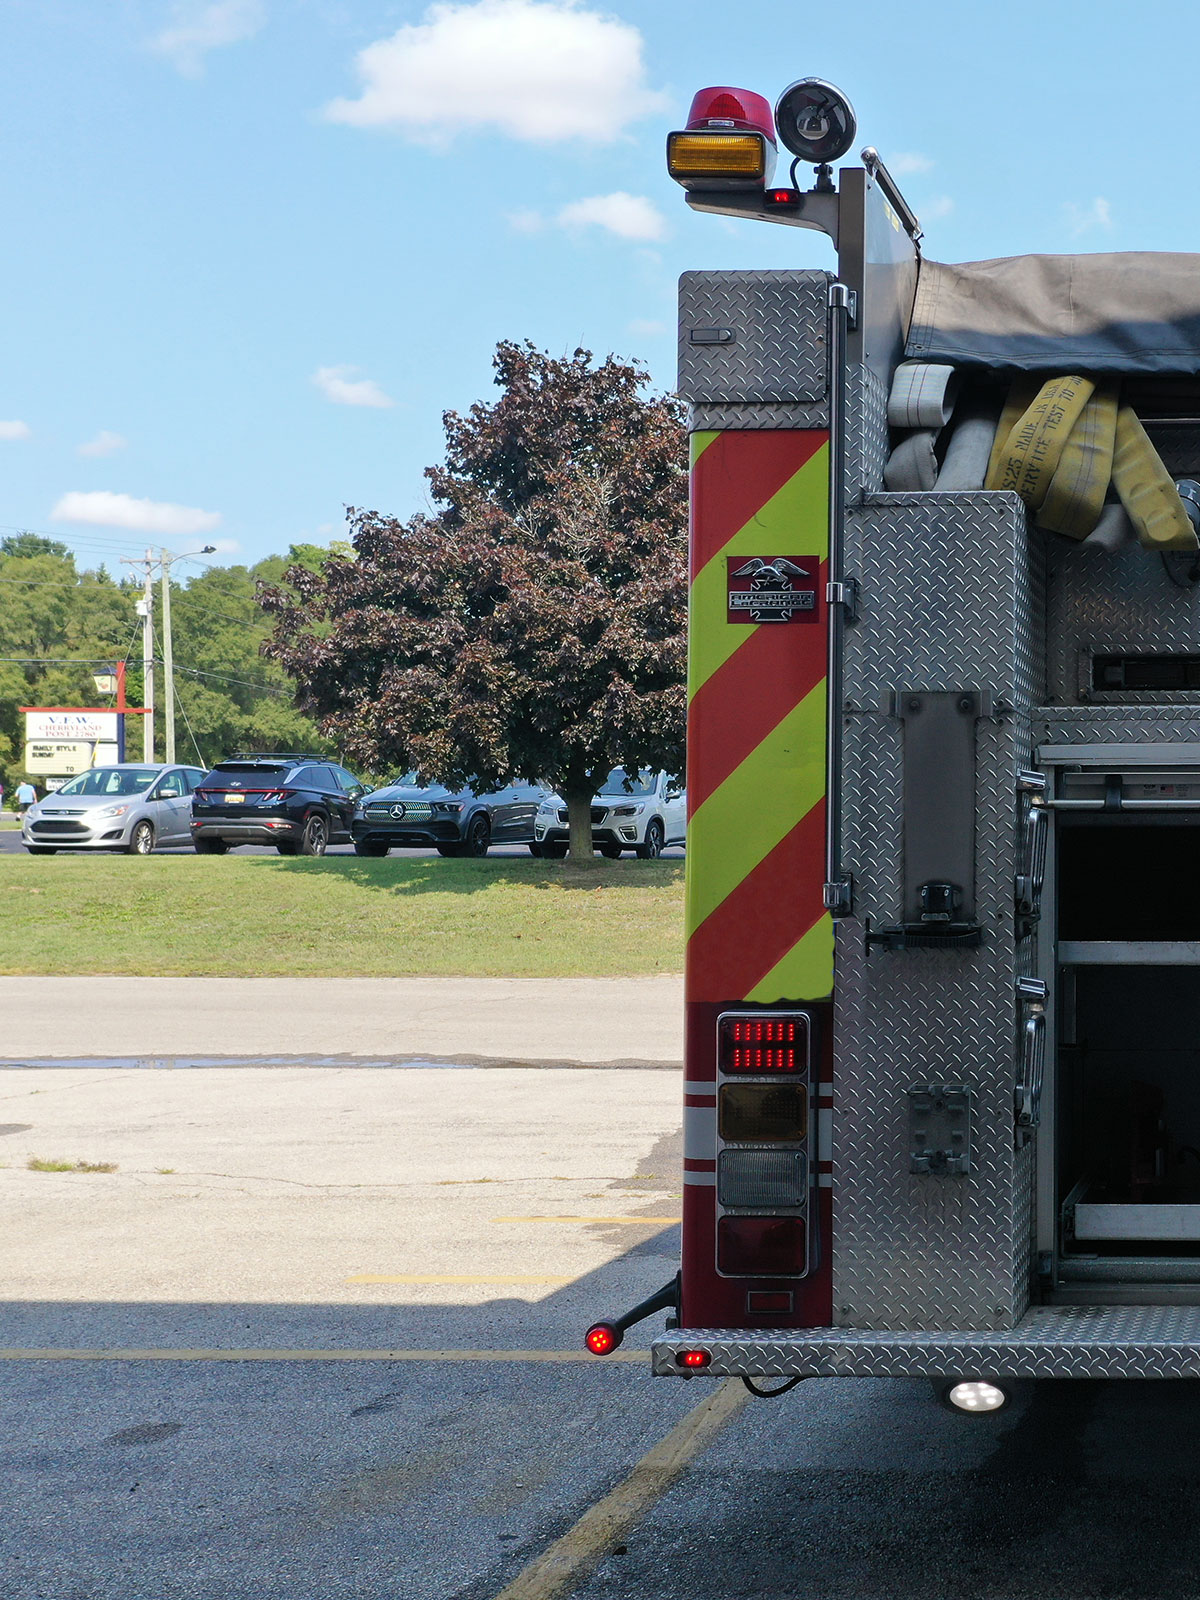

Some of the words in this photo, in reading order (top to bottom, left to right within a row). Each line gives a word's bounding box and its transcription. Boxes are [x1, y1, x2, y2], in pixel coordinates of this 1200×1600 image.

[1042, 403, 1066, 430] TEST
[1001, 457, 1023, 491] S25
[1015, 422, 1039, 451] MADE
